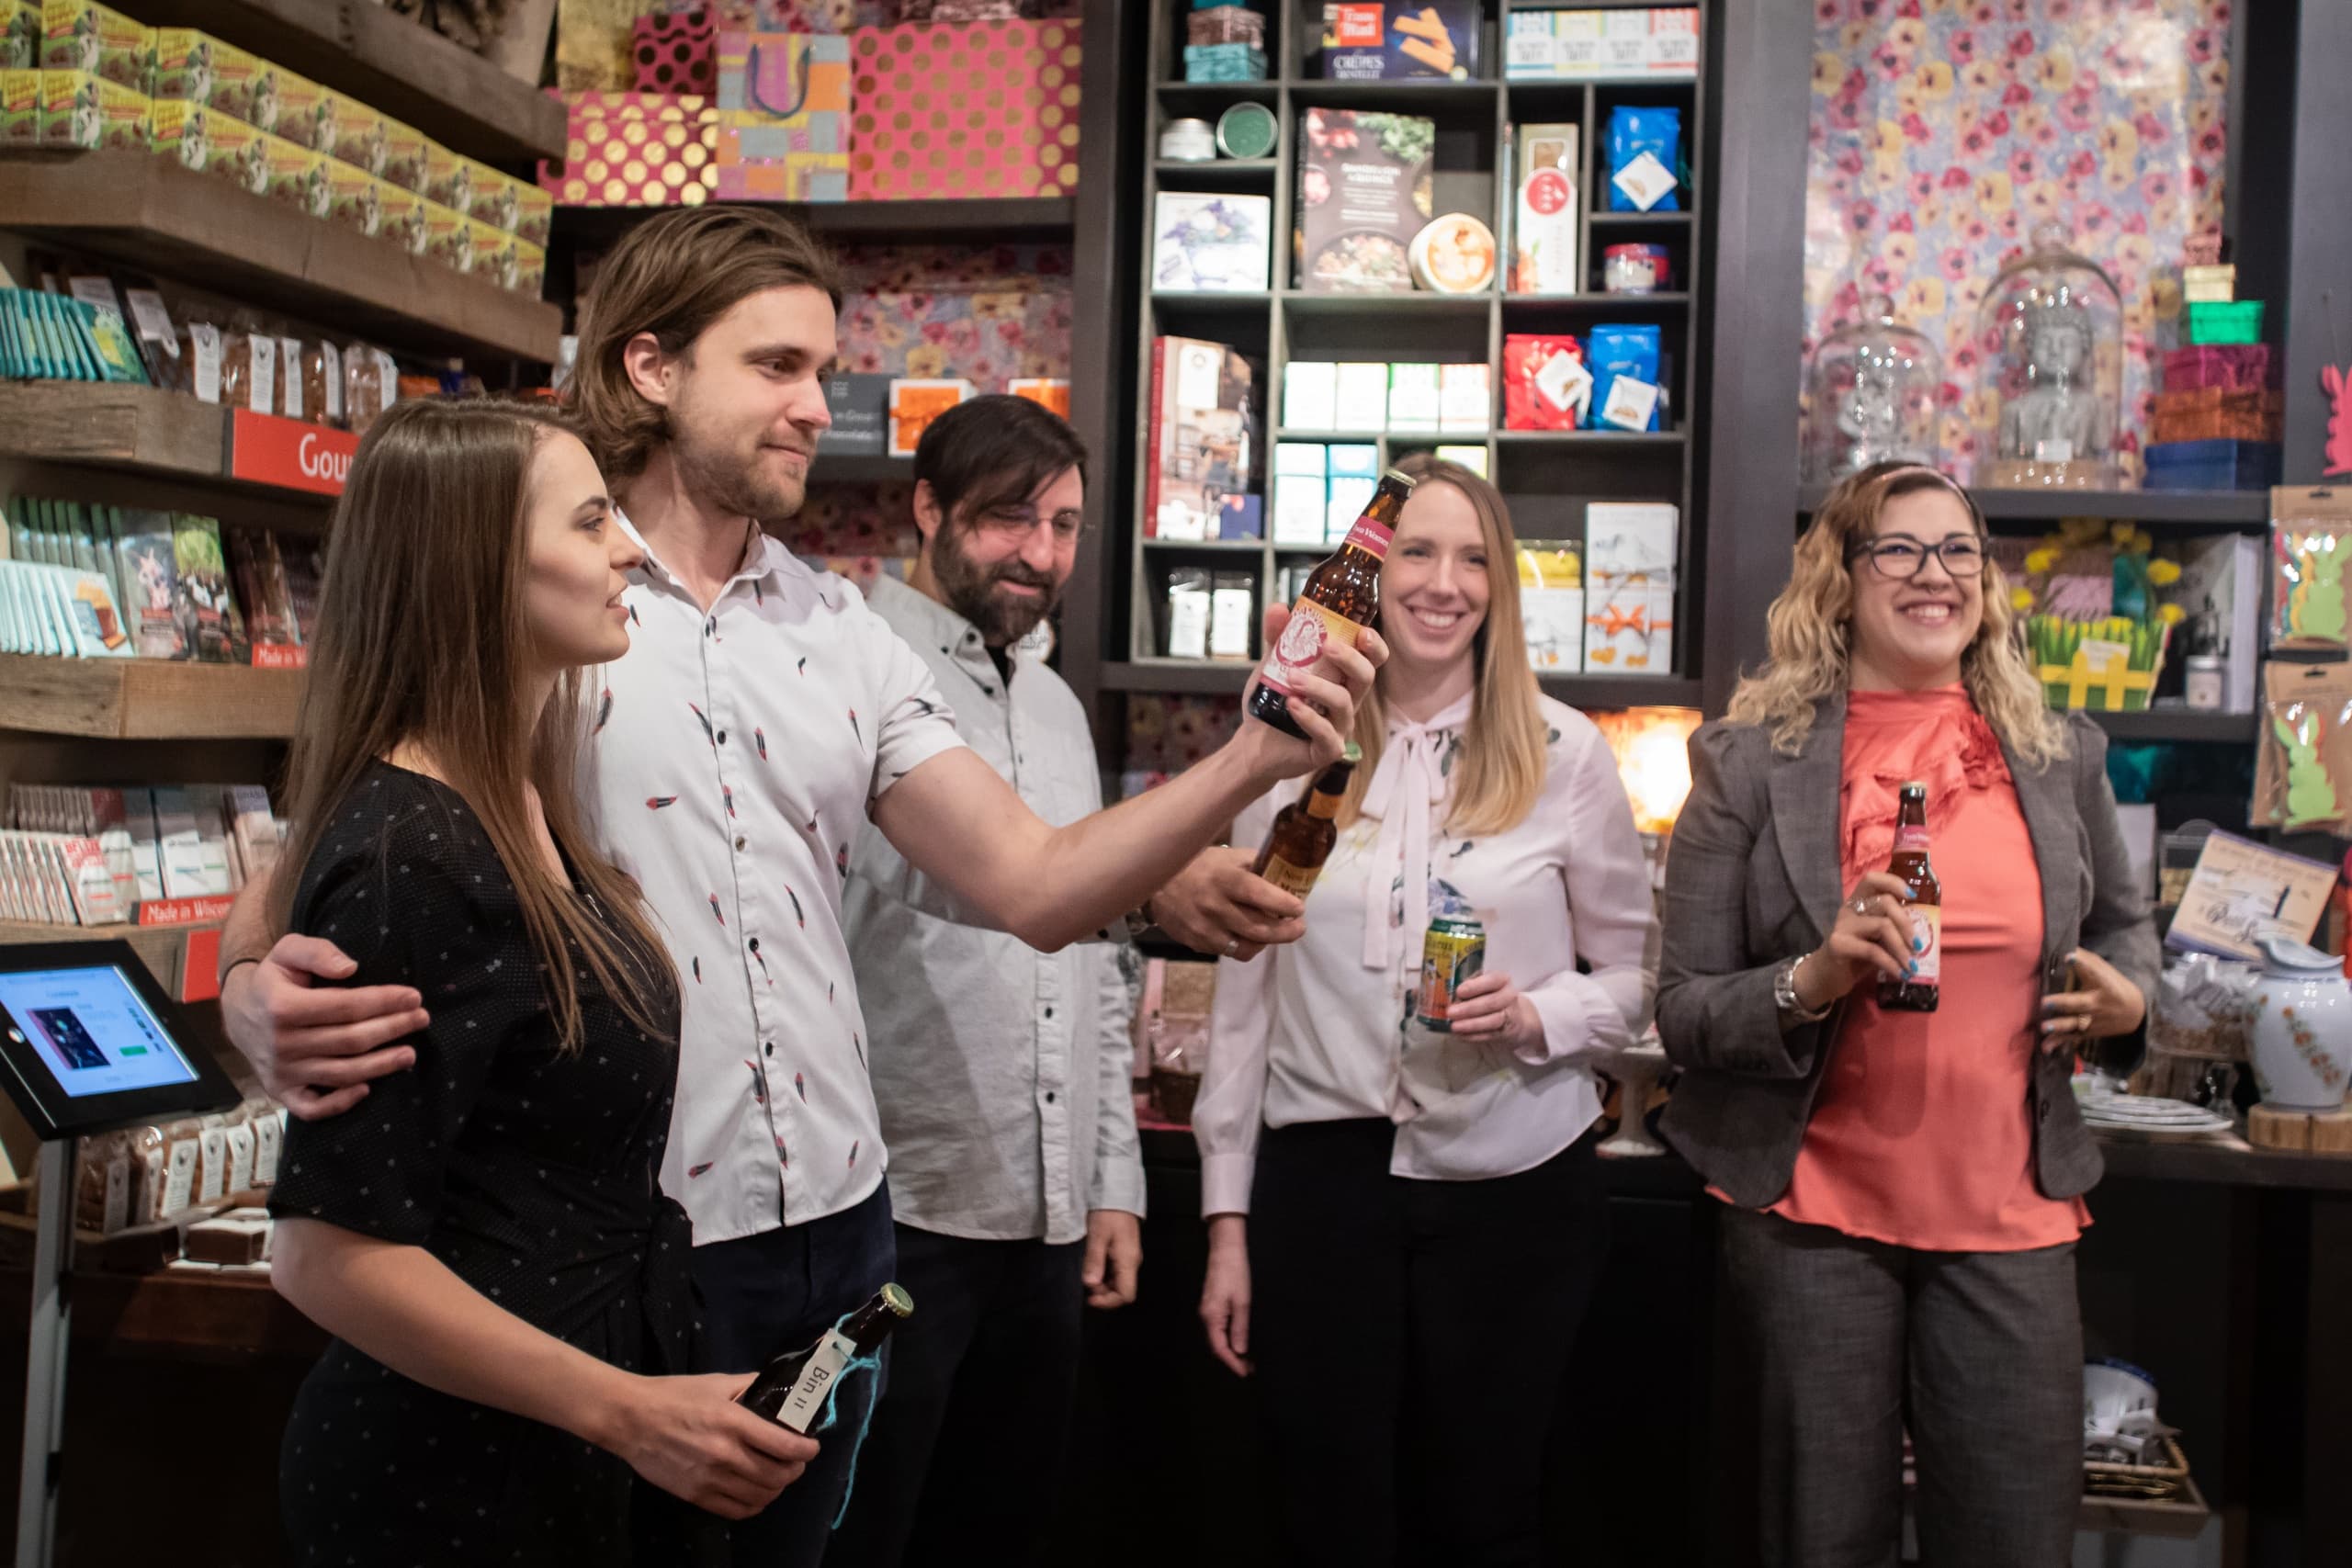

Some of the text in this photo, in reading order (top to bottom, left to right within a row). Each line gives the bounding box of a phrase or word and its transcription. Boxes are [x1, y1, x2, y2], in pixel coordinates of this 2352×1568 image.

[147, 902, 178, 924] Made
[180, 900, 191, 919] in
[802, 1366, 831, 1393] Bin
